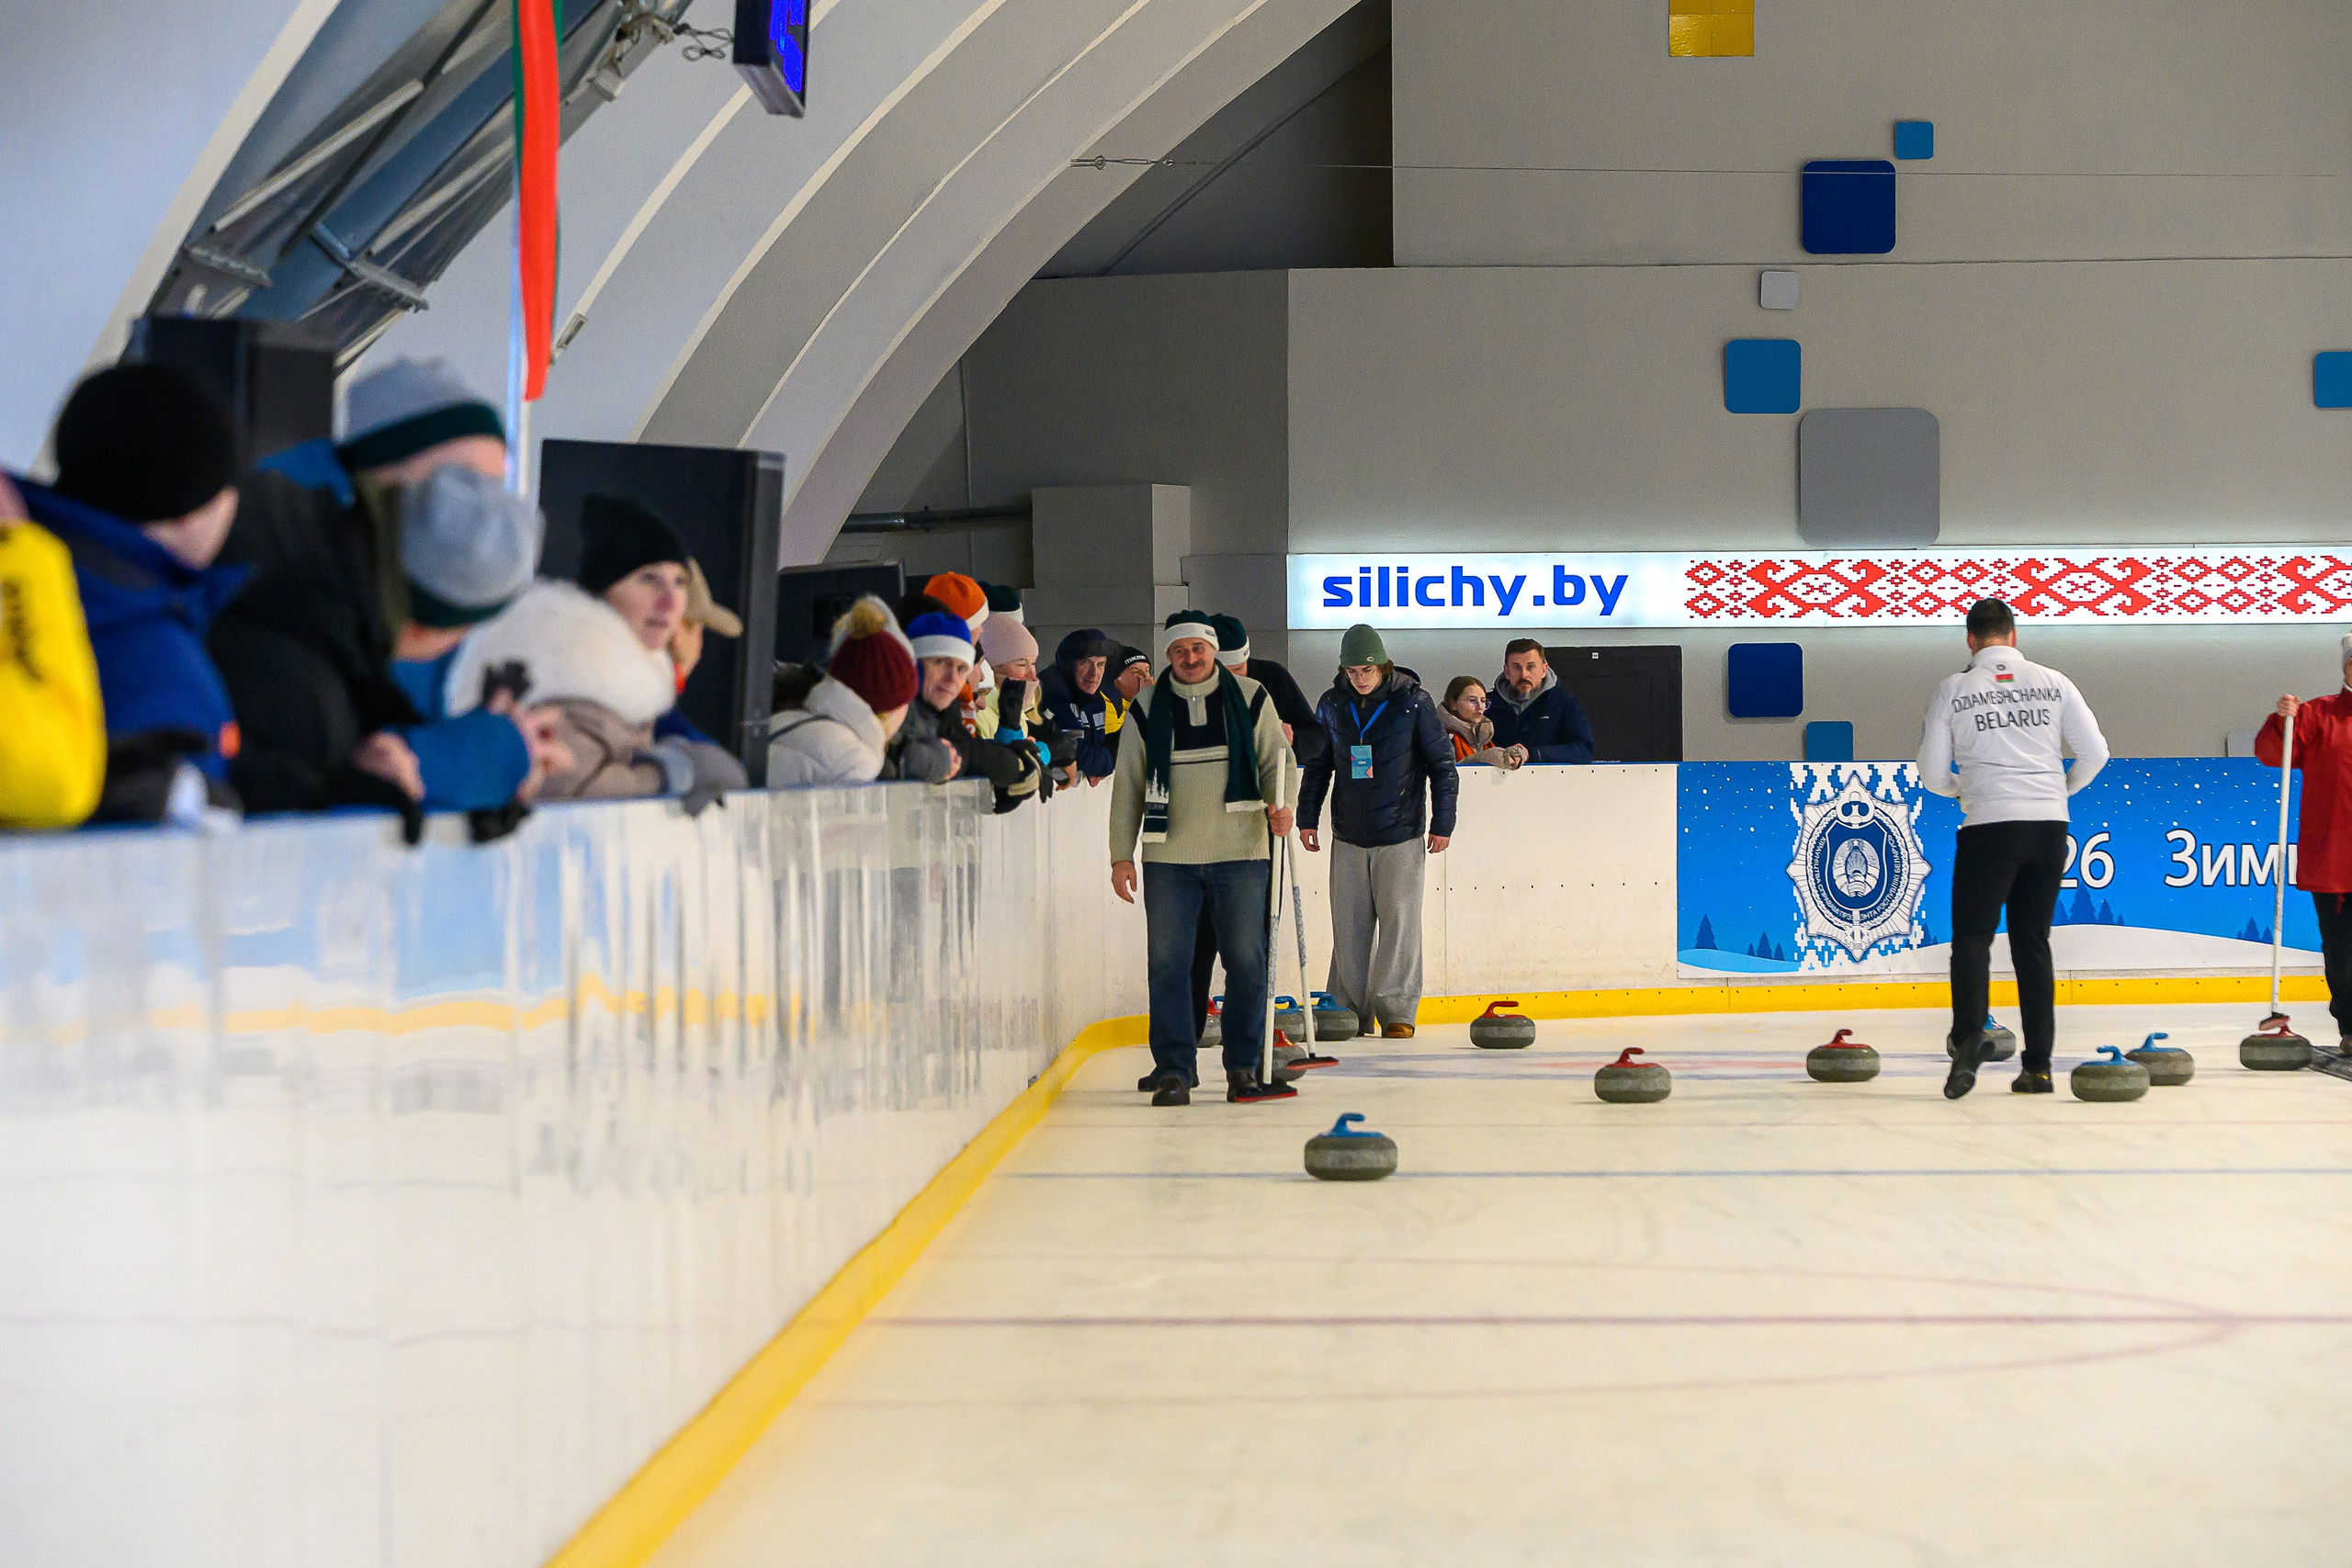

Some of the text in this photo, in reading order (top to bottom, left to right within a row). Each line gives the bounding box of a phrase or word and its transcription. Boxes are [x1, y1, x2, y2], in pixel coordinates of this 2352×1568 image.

[1323, 565, 1629, 616] silichy.by
[1951, 688, 2063, 713] DZIAMESHCHANKA
[1974, 708, 2051, 731] BELARUS
[2164, 829, 2298, 887] Зим
